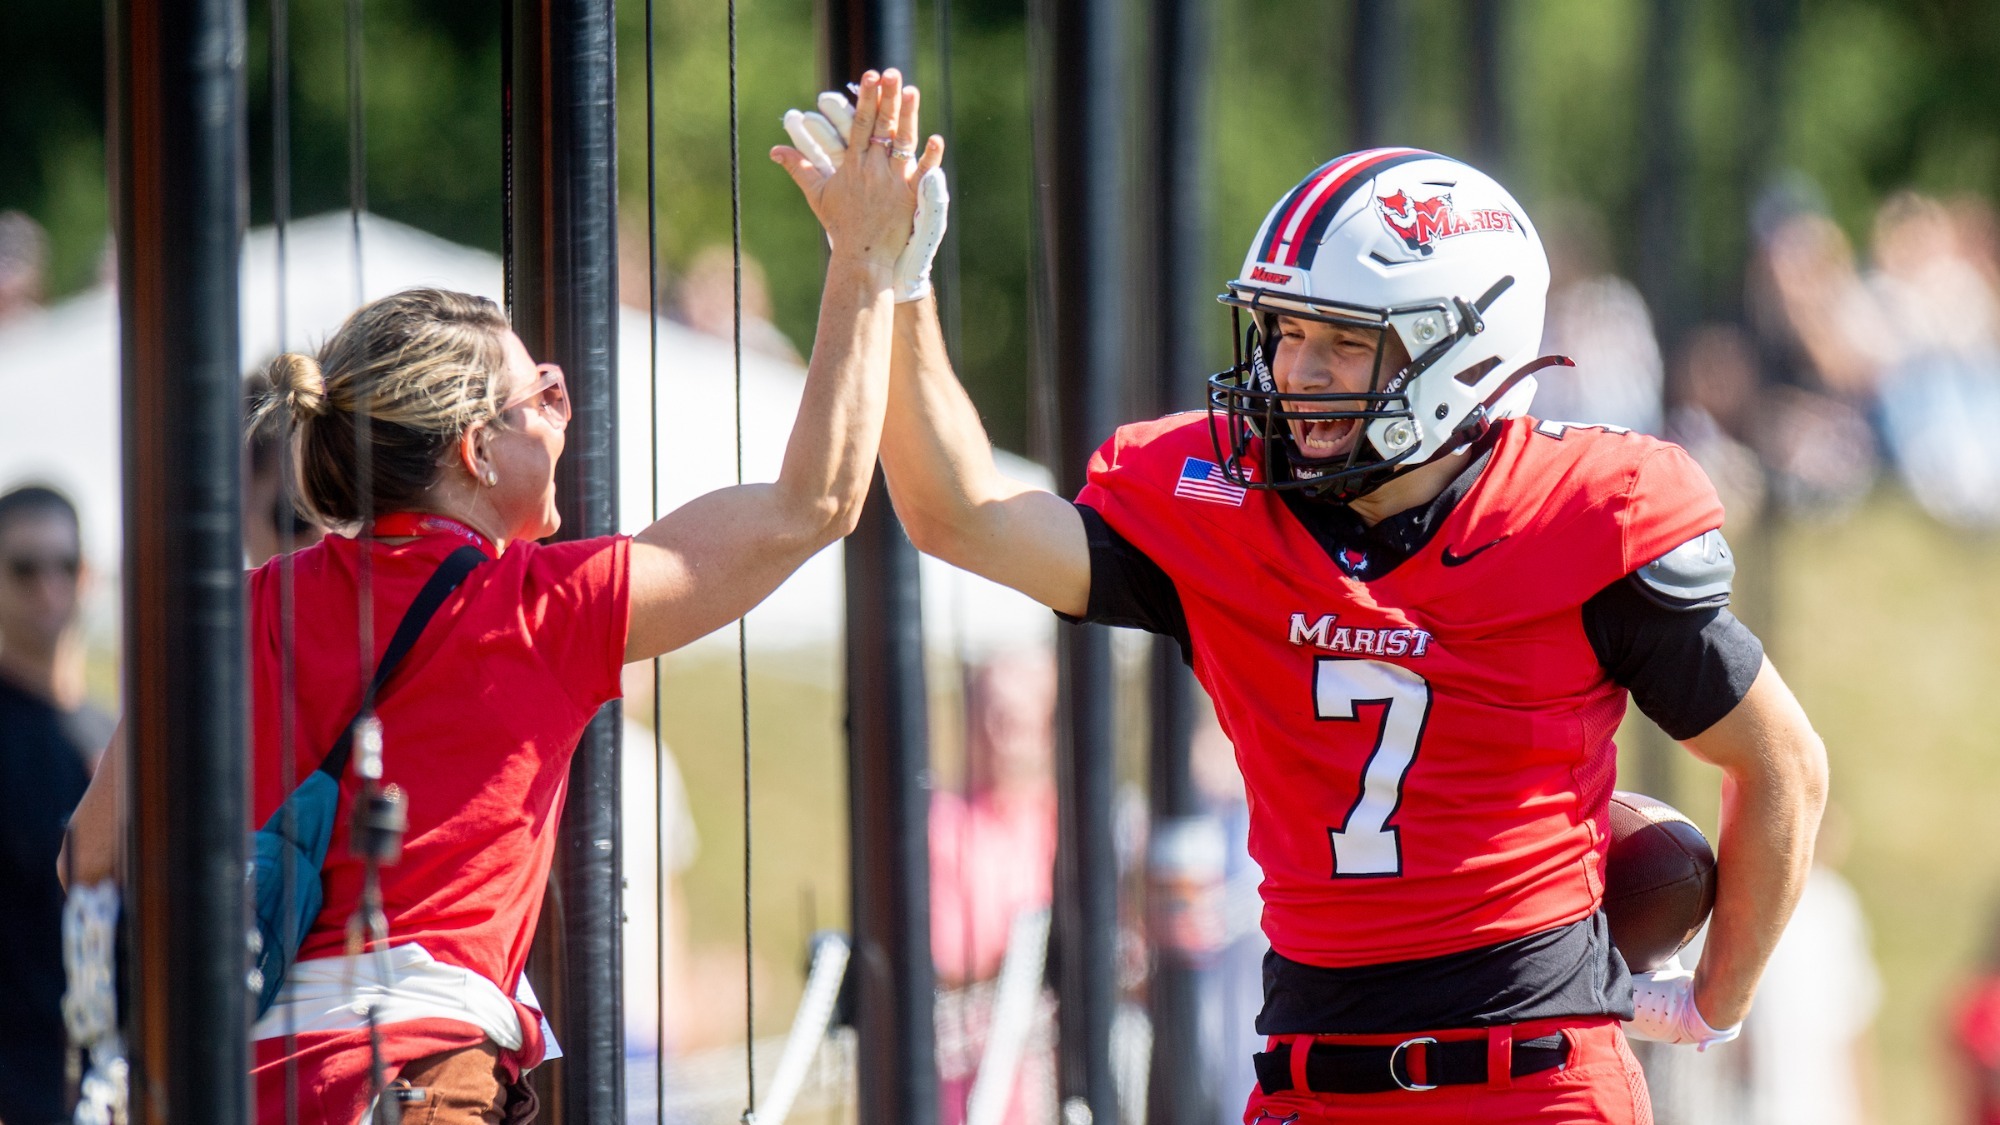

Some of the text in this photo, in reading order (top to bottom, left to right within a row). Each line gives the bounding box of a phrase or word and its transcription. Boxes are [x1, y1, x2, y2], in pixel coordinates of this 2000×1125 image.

[1416, 205, 1514, 246] MARIST
[1288, 612, 1433, 657] MARIST
[1313, 655, 1433, 880] 7
